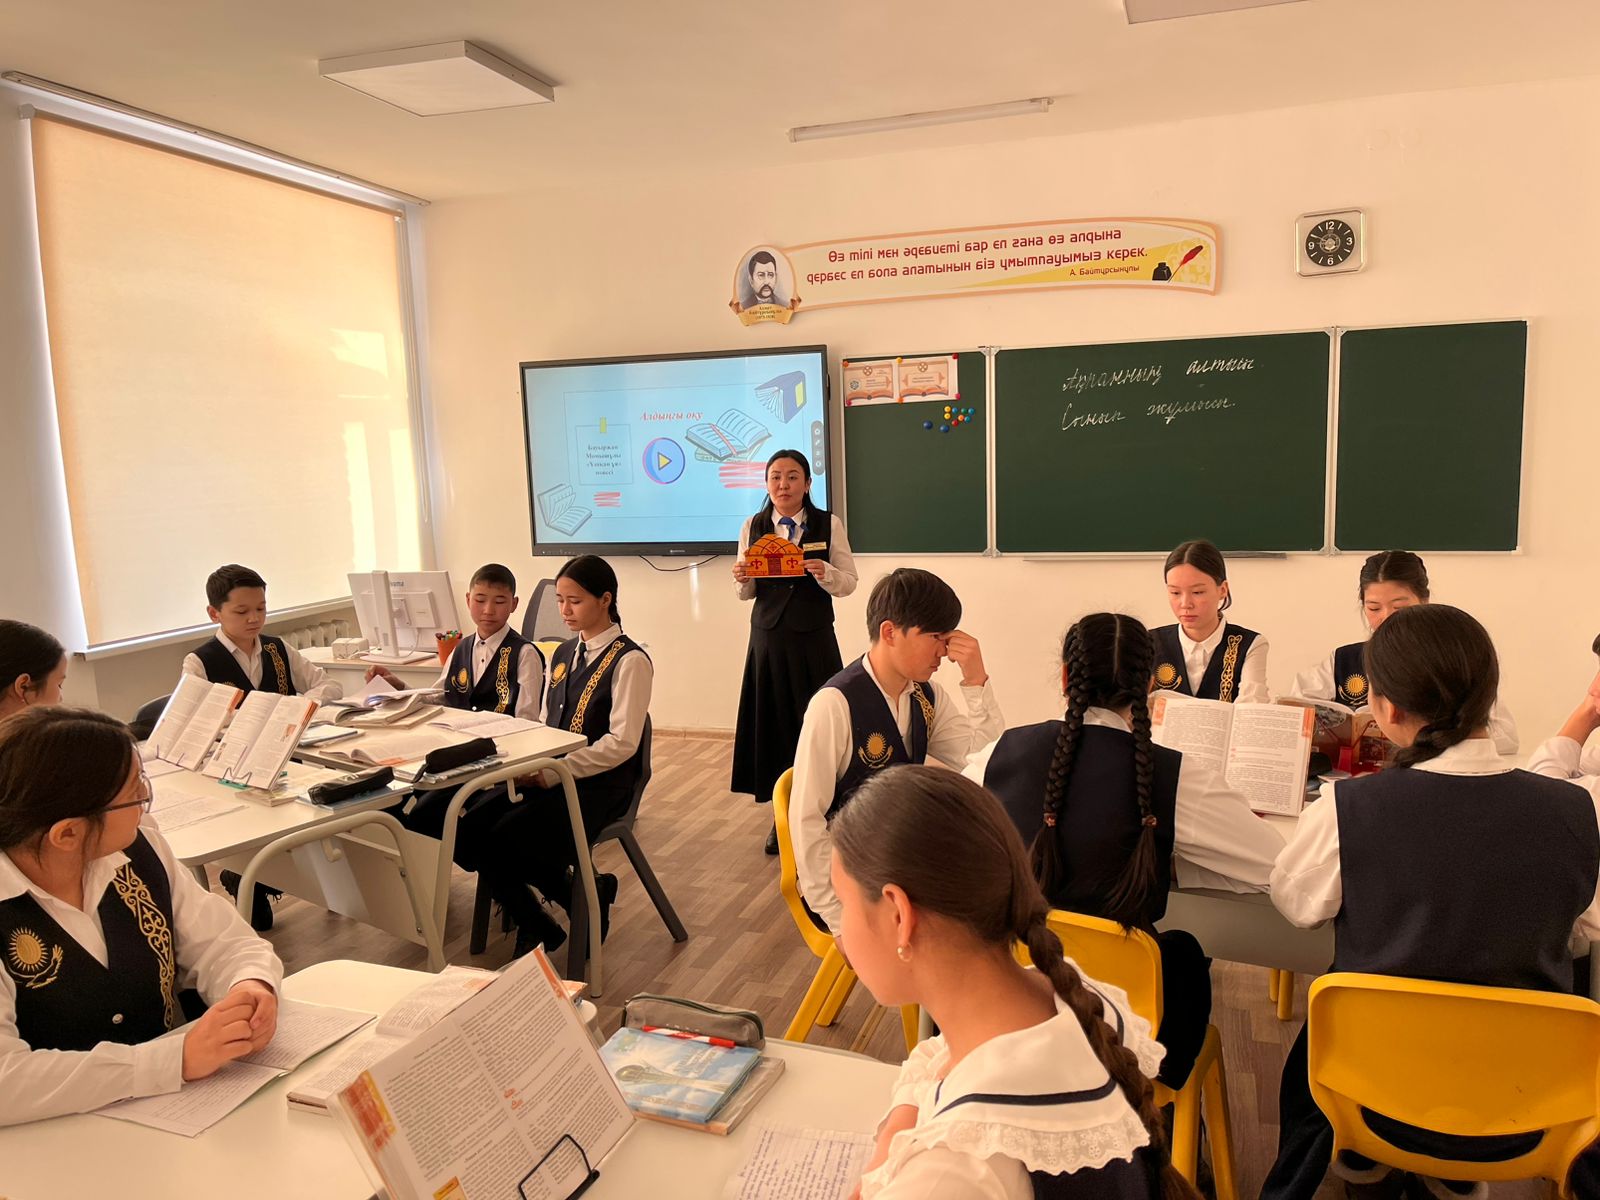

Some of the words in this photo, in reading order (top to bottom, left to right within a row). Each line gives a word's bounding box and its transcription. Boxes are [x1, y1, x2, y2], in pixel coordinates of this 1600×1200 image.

[1325, 221, 1335, 230] 12
[828, 250, 845, 262] Өз
[849, 248, 873, 261] тілі
[877, 248, 899, 259] мен
[903, 241, 960, 258] әдебиеті
[964, 240, 988, 253] бар
[992, 239, 1007, 250] ел
[1048, 234, 1065, 245] өз
[1070, 229, 1122, 245] алдына
[1308, 241, 1315, 250] 9
[1346, 237, 1353, 246] 3
[1327, 257, 1334, 265] 6
[807, 270, 847, 285] дербес
[850, 270, 864, 280] ел
[868, 267, 898, 279] бола
[902, 261, 971, 276] алатынын
[975, 257, 995, 270] біз
[1000, 251, 1101, 271] ұмытпауымыз
[1106, 247, 1148, 261] керек.
